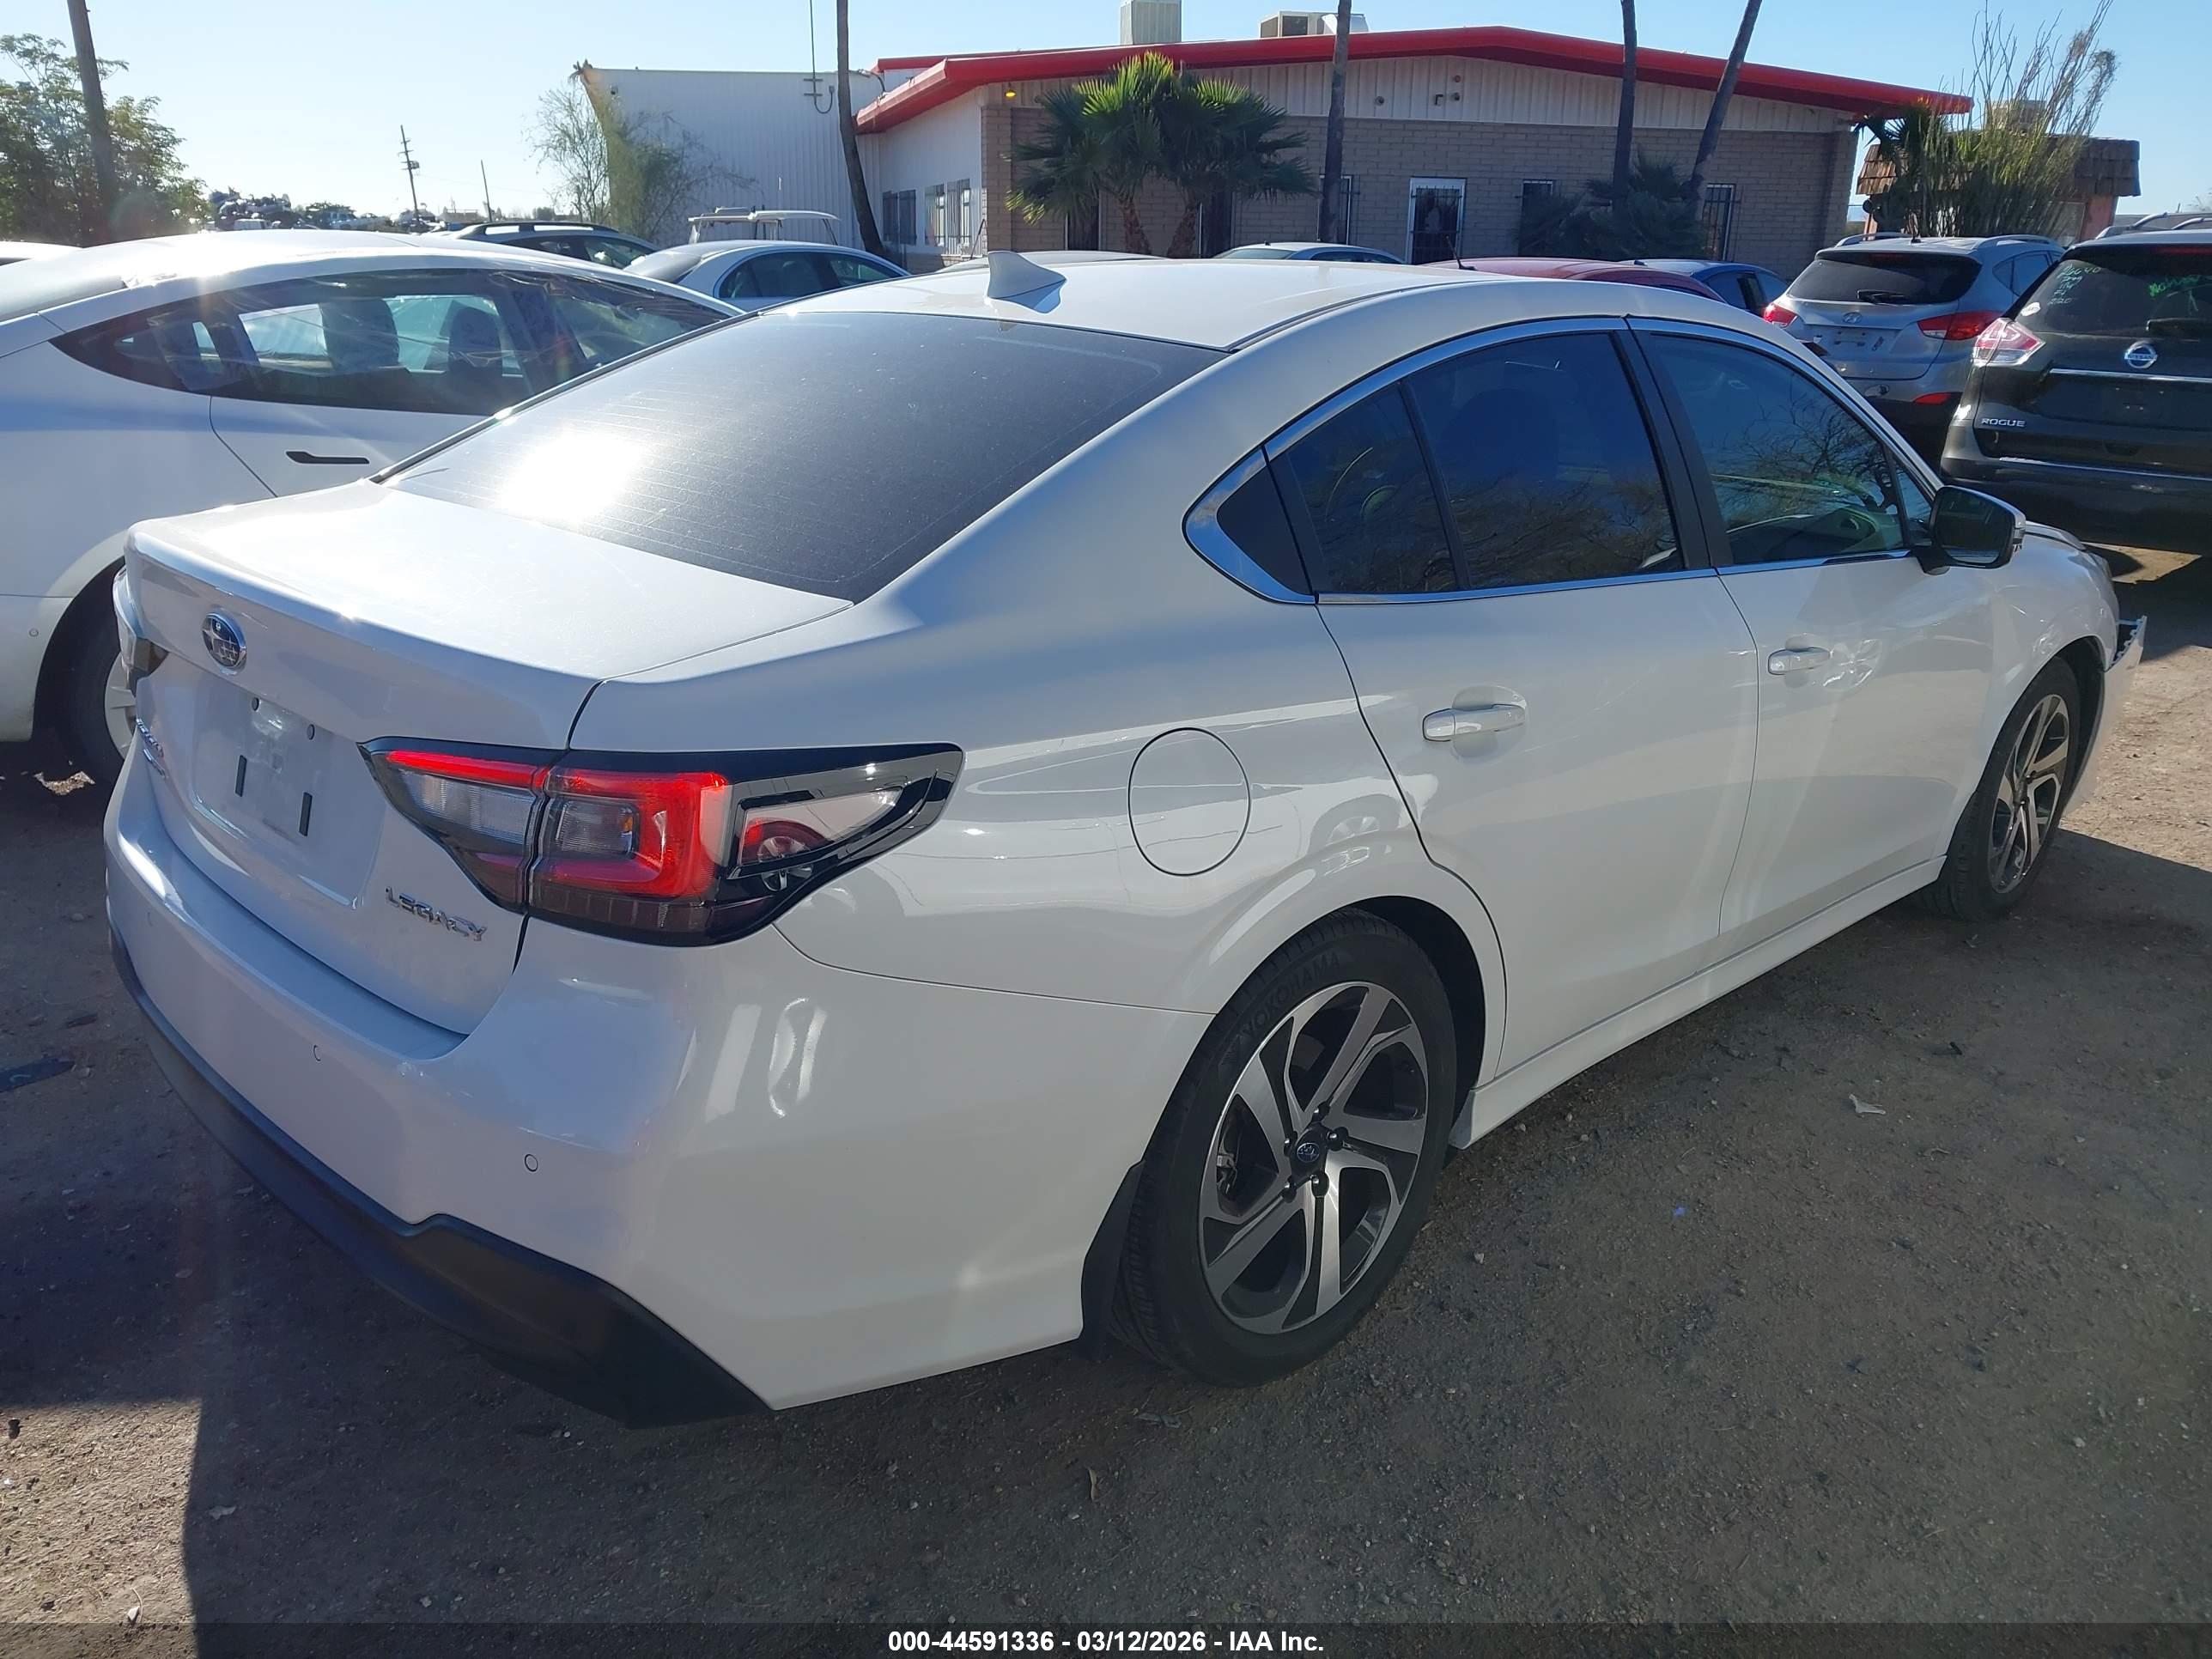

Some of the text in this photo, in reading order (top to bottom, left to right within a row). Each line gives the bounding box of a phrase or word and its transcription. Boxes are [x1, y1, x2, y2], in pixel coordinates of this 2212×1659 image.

[1981, 417, 2027, 428] ROGUE
[385, 885, 488, 942] LEGACY
[1242, 951, 1340, 1036] YOKOHAMA
